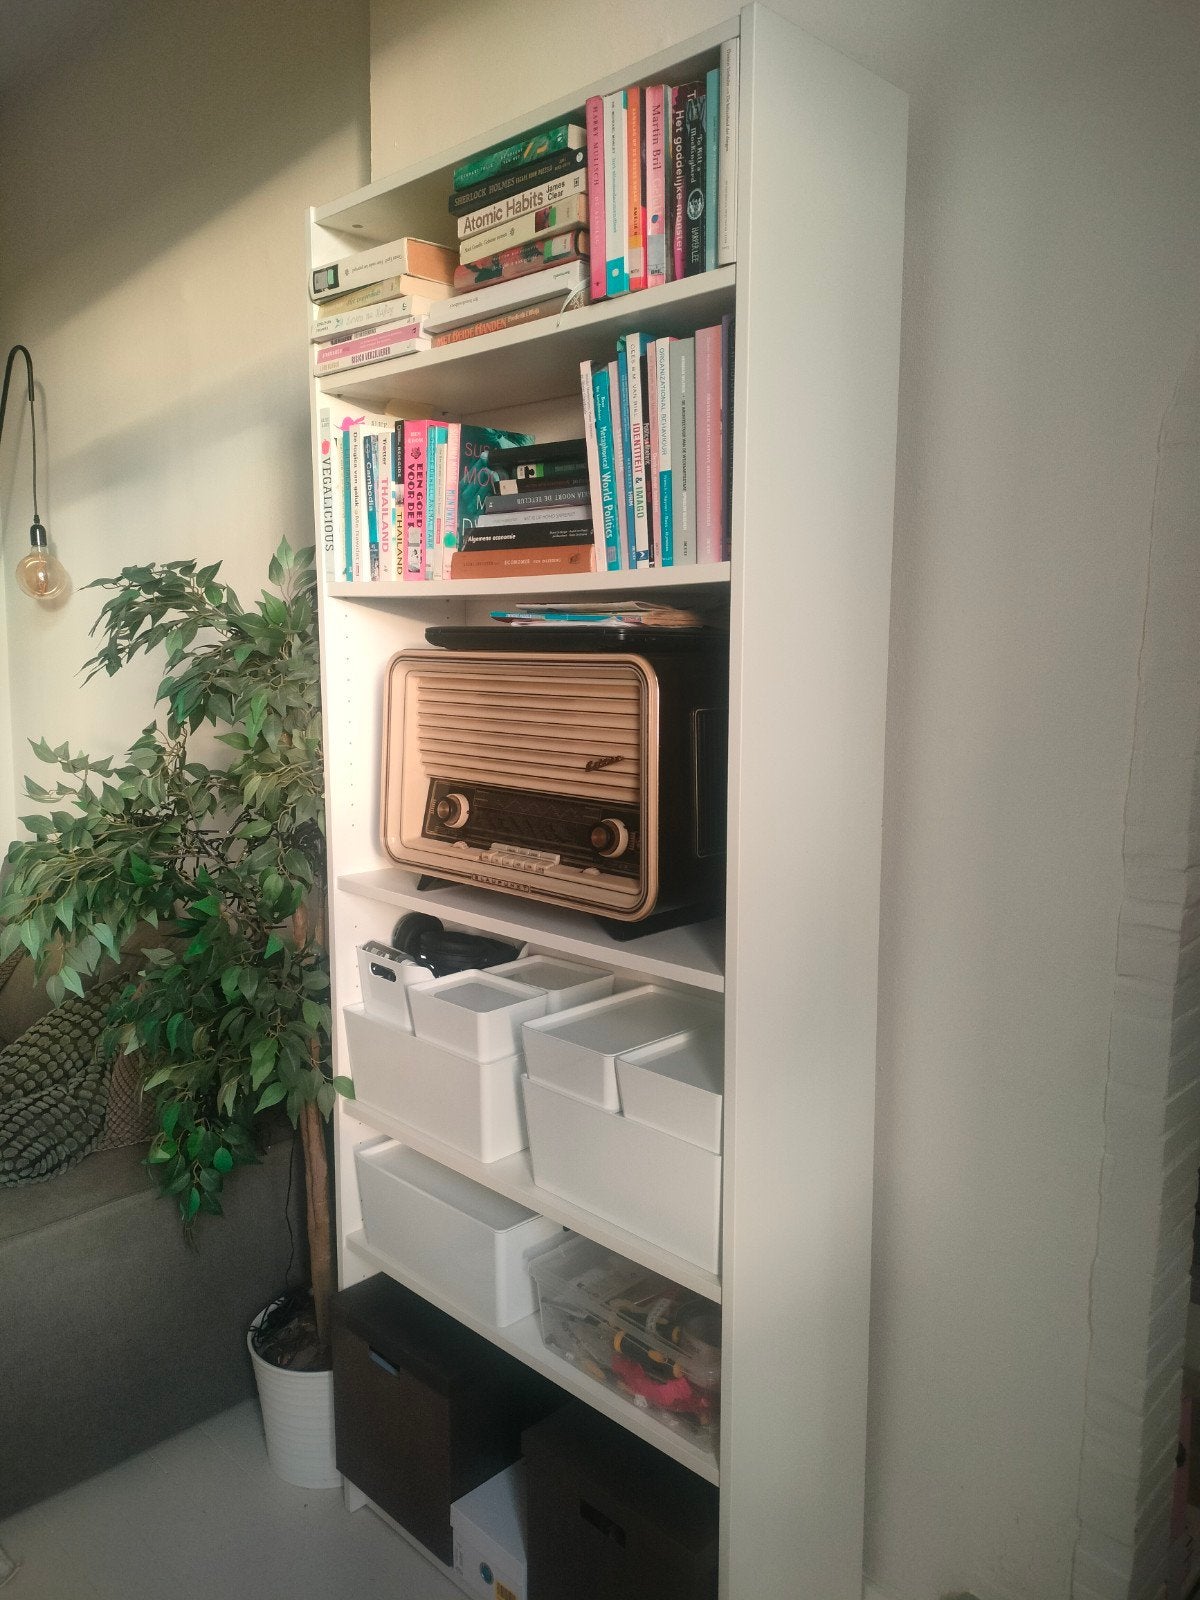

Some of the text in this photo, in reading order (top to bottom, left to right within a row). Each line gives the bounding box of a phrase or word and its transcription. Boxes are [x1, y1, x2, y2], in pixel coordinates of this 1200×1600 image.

[652, 104, 661, 145] Martin
[675, 109, 685, 133] Het
[688, 127, 697, 183] Mockingbird
[697, 133, 703, 145] To
[652, 149, 662, 170] Bril
[673, 136, 685, 200] goddelijke
[454, 187, 487, 207] SHERLOCK
[488, 176, 516, 195] HOLMES
[546, 180, 566, 194] James
[547, 189, 564, 201] Clear
[463, 190, 544, 234] Atomic Habits
[691, 227, 700, 264] HARPER LEE
[436, 333, 453, 348] MET
[474, 317, 507, 337] HANDEN
[659, 347, 667, 413] ORGANIZATIONAL
[633, 423, 643, 474] IDENTITEIT
[366, 461, 374, 512] Cambodia
[544, 494, 552, 502] DE
[554, 492, 576, 502] NOORT
[600, 425, 615, 539] Metaphorical World Politics
[322, 457, 334, 552] VEGALICIOUS
[381, 477, 389, 553] THAILAND
[407, 502, 415, 519] DE
[416, 491, 424, 528] GOED
[636, 486, 645, 518] IMAGO
[492, 533, 516, 541] economie
[472, 873, 530, 893] BLAUPUNKT
